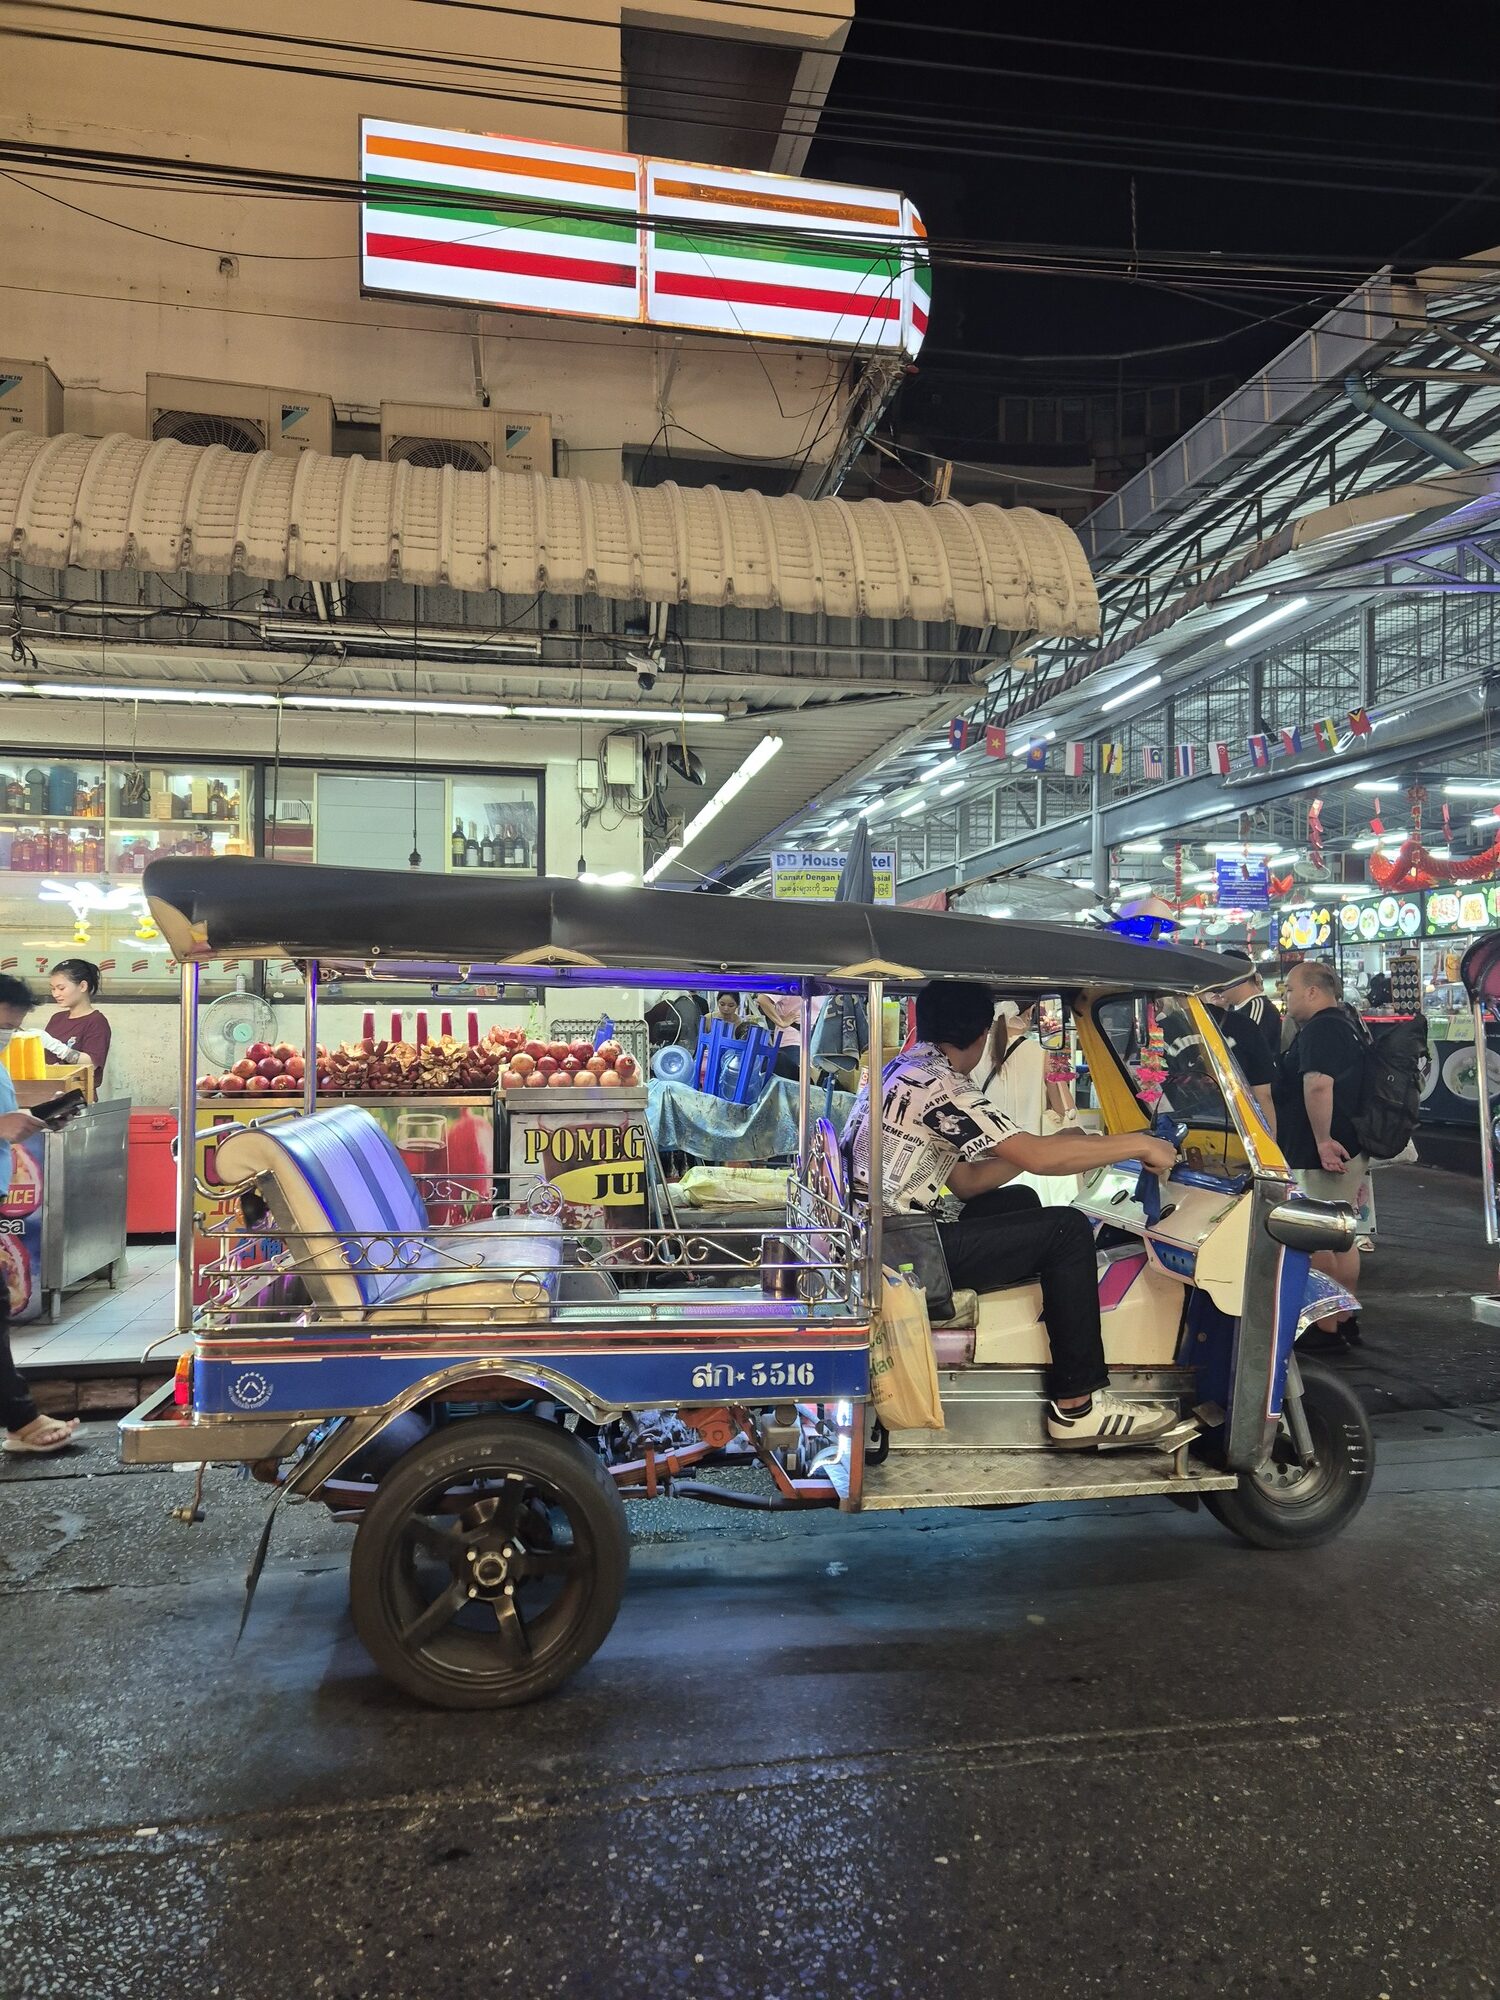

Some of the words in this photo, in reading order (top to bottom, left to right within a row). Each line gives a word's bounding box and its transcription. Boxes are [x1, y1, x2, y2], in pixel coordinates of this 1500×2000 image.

[802, 854, 846, 867] House
[871, 855, 891, 868] tel
[805, 873, 836, 884] Dengan
[524, 1125, 645, 1164] POMEG
[751, 1362, 815, 1386] 5516
